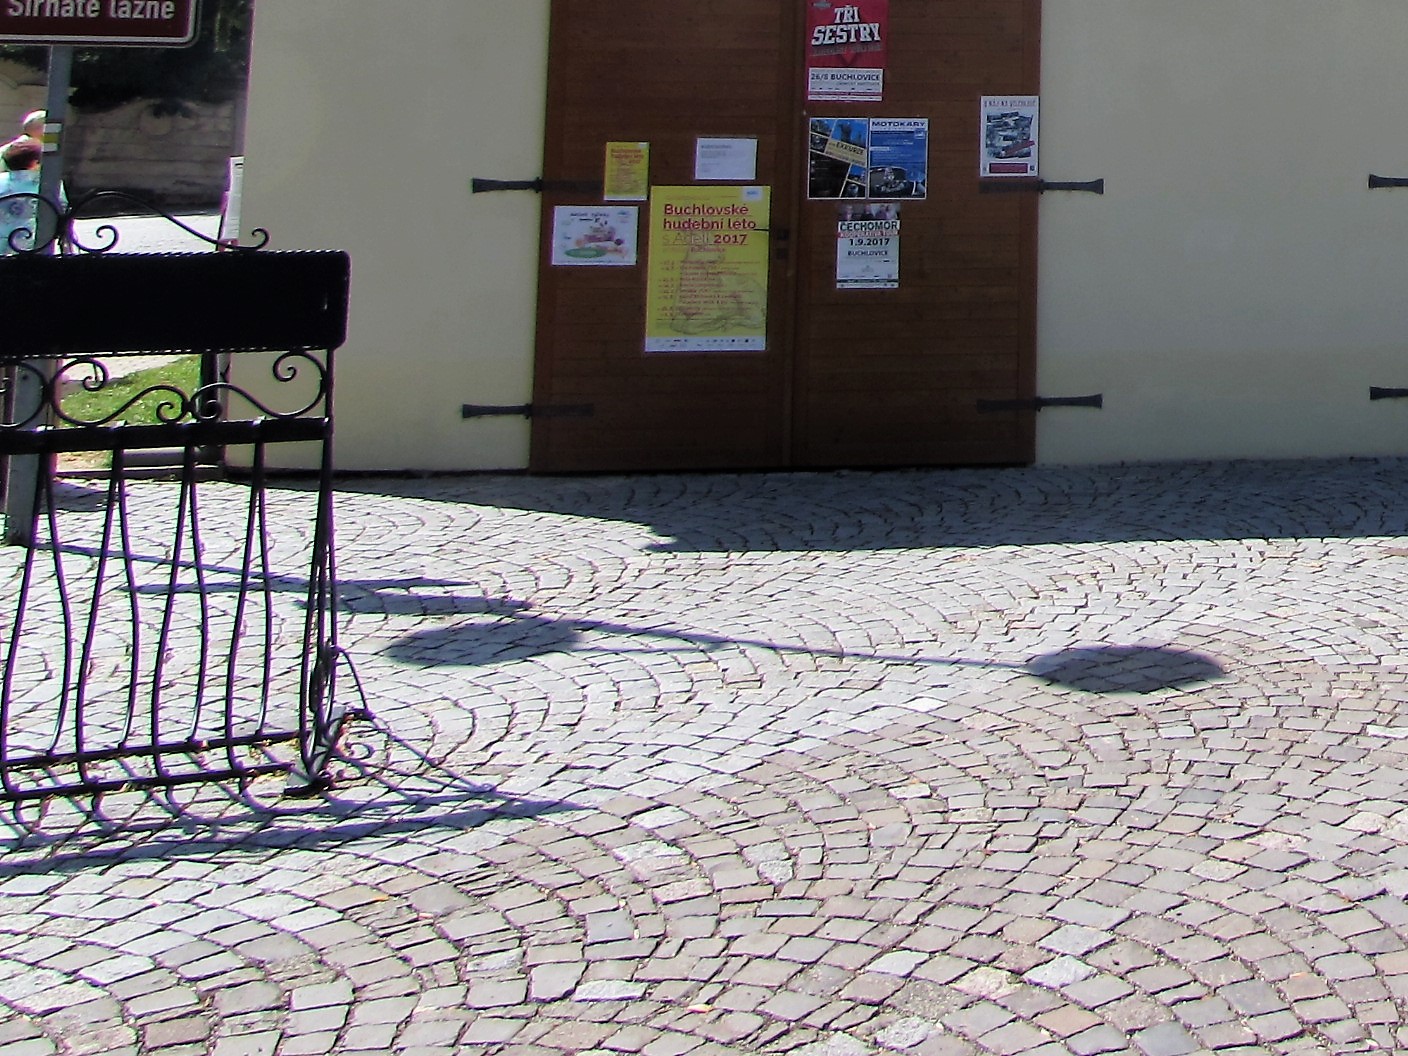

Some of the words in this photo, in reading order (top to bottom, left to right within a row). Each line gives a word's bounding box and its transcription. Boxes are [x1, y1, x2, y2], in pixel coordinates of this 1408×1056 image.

[834, 5, 860, 23] TŘI
[811, 23, 881, 46] SESTRY
[664, 203, 749, 215] Buchlovské
[663, 218, 724, 230] hudební
[728, 218, 757, 230] léto
[714, 234, 747, 244] 2017
[849, 238, 890, 246] 1.9.2017
